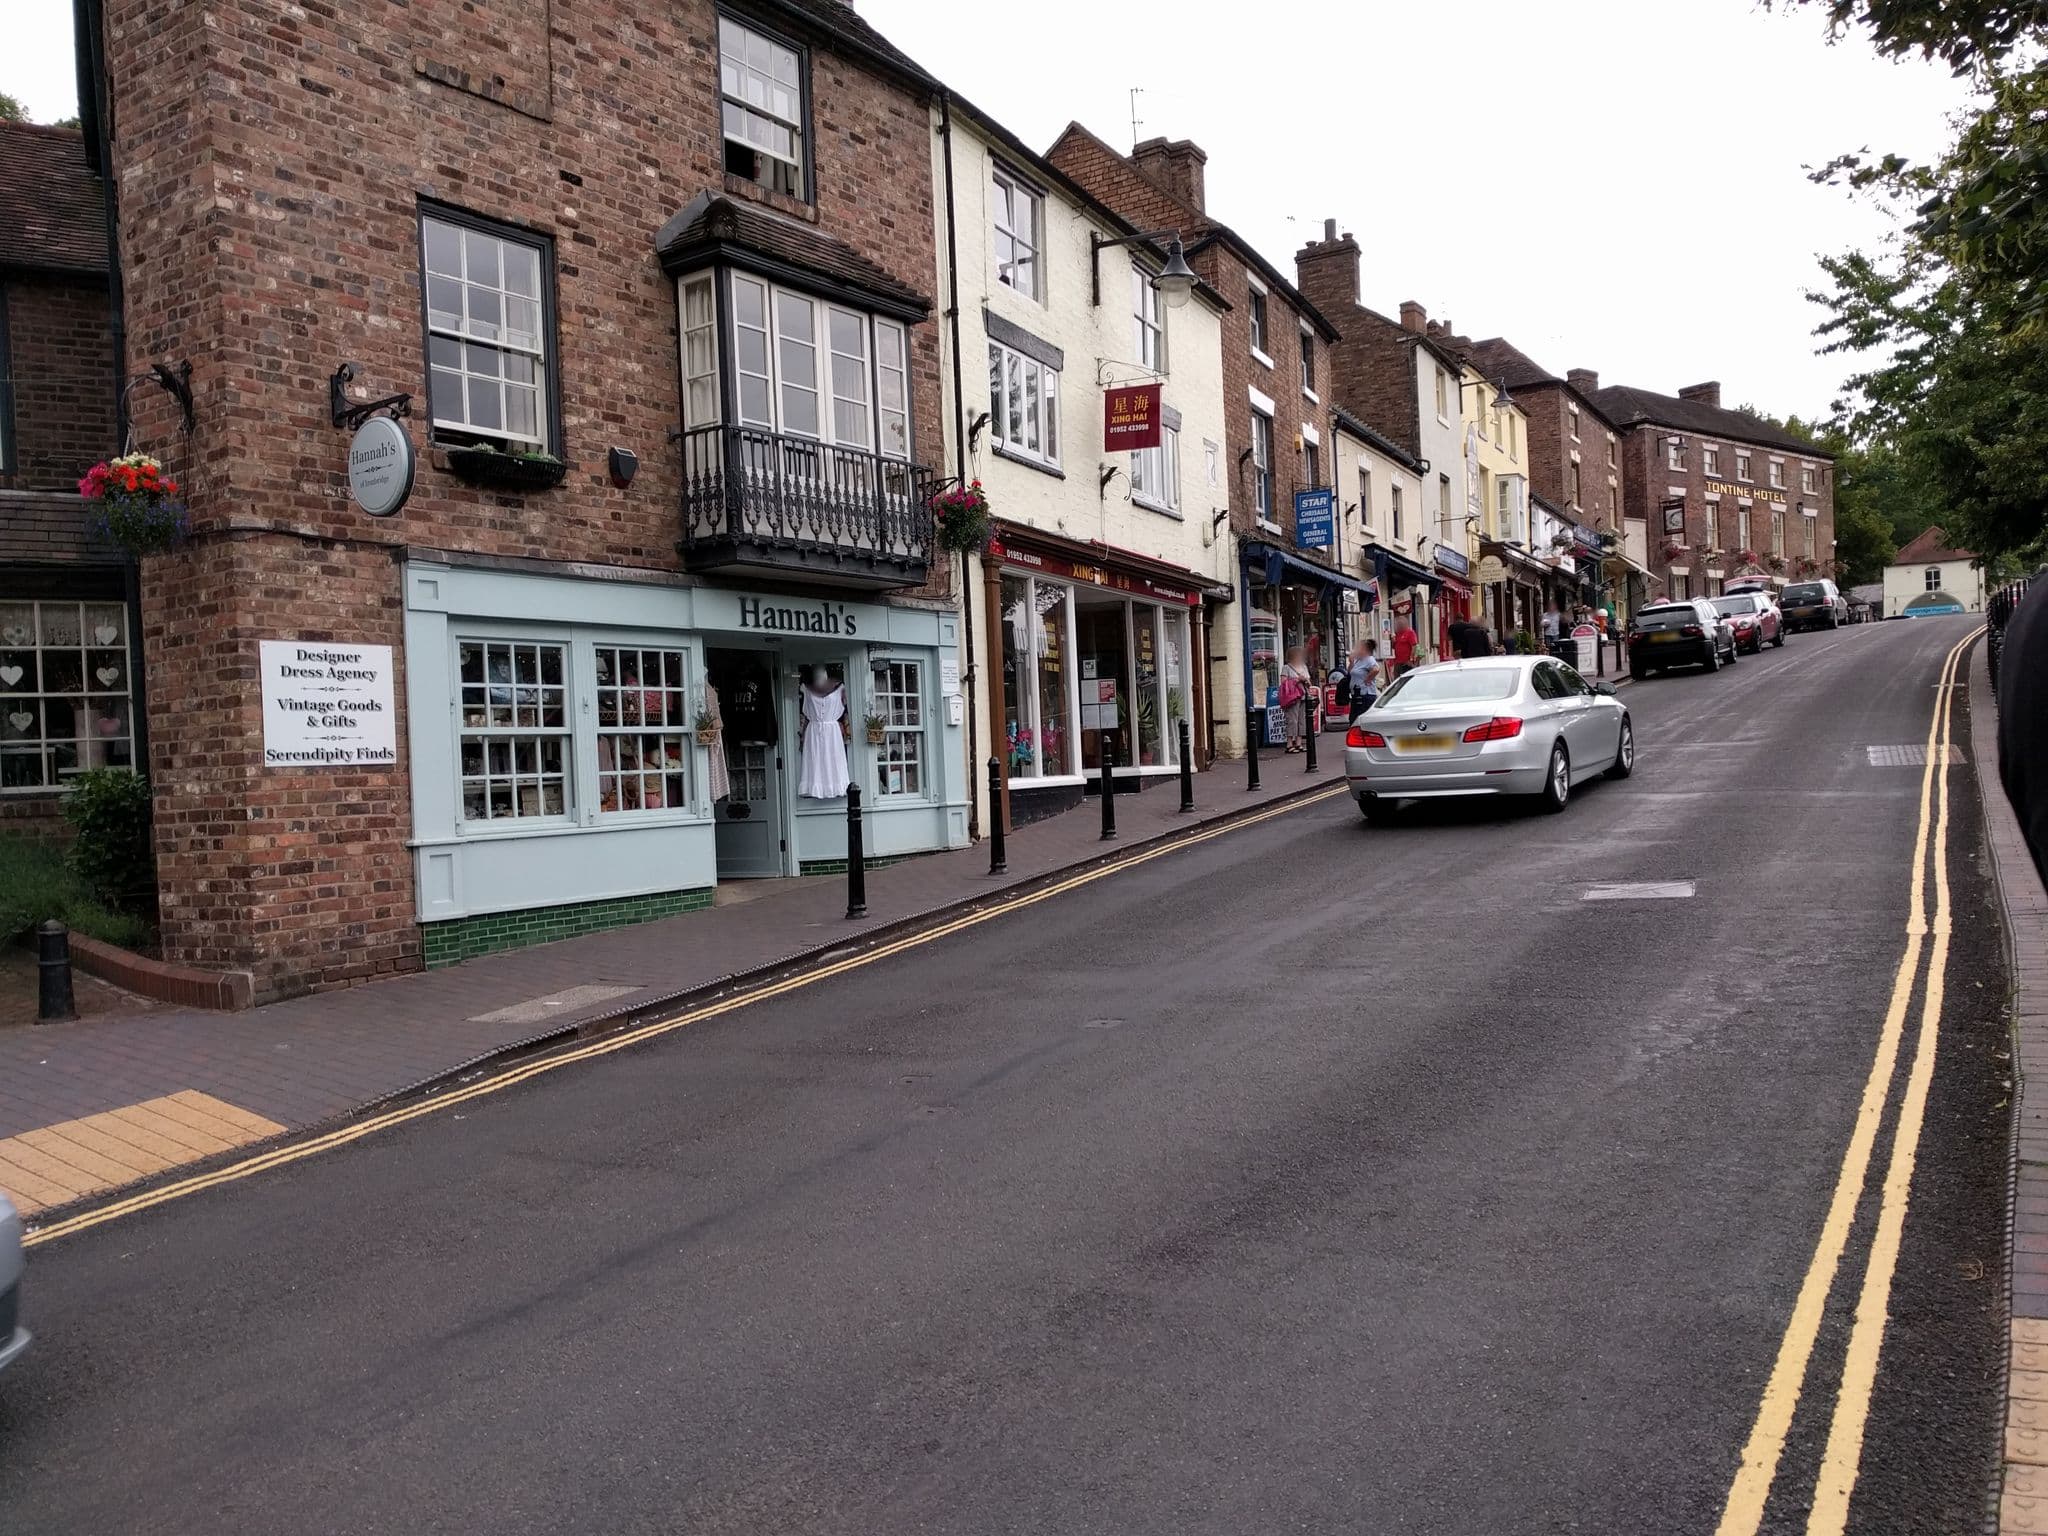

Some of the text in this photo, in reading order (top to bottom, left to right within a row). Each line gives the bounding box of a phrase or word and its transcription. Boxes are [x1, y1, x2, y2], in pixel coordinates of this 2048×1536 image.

[1111, 413, 1147, 424] XING HAI
[1109, 425, 1127, 434] 01952
[352, 441, 396, 465] Hannah's
[1706, 481, 1786, 503] TONTINE HOTEL
[1301, 497, 1327, 508] STAR
[1303, 529, 1327, 537] GENERAL
[1305, 536, 1325, 544] STORES
[1006, 549, 1023, 562] 01952
[1072, 562, 1094, 581] XING
[738, 597, 857, 636] Hannah's
[296, 649, 362, 665] Designer
[280, 665, 378, 683] Dress Agency
[277, 698, 383, 713] Vintage Goods
[306, 715, 358, 728] & Gifts
[266, 747, 394, 763] Serendipity Finds
